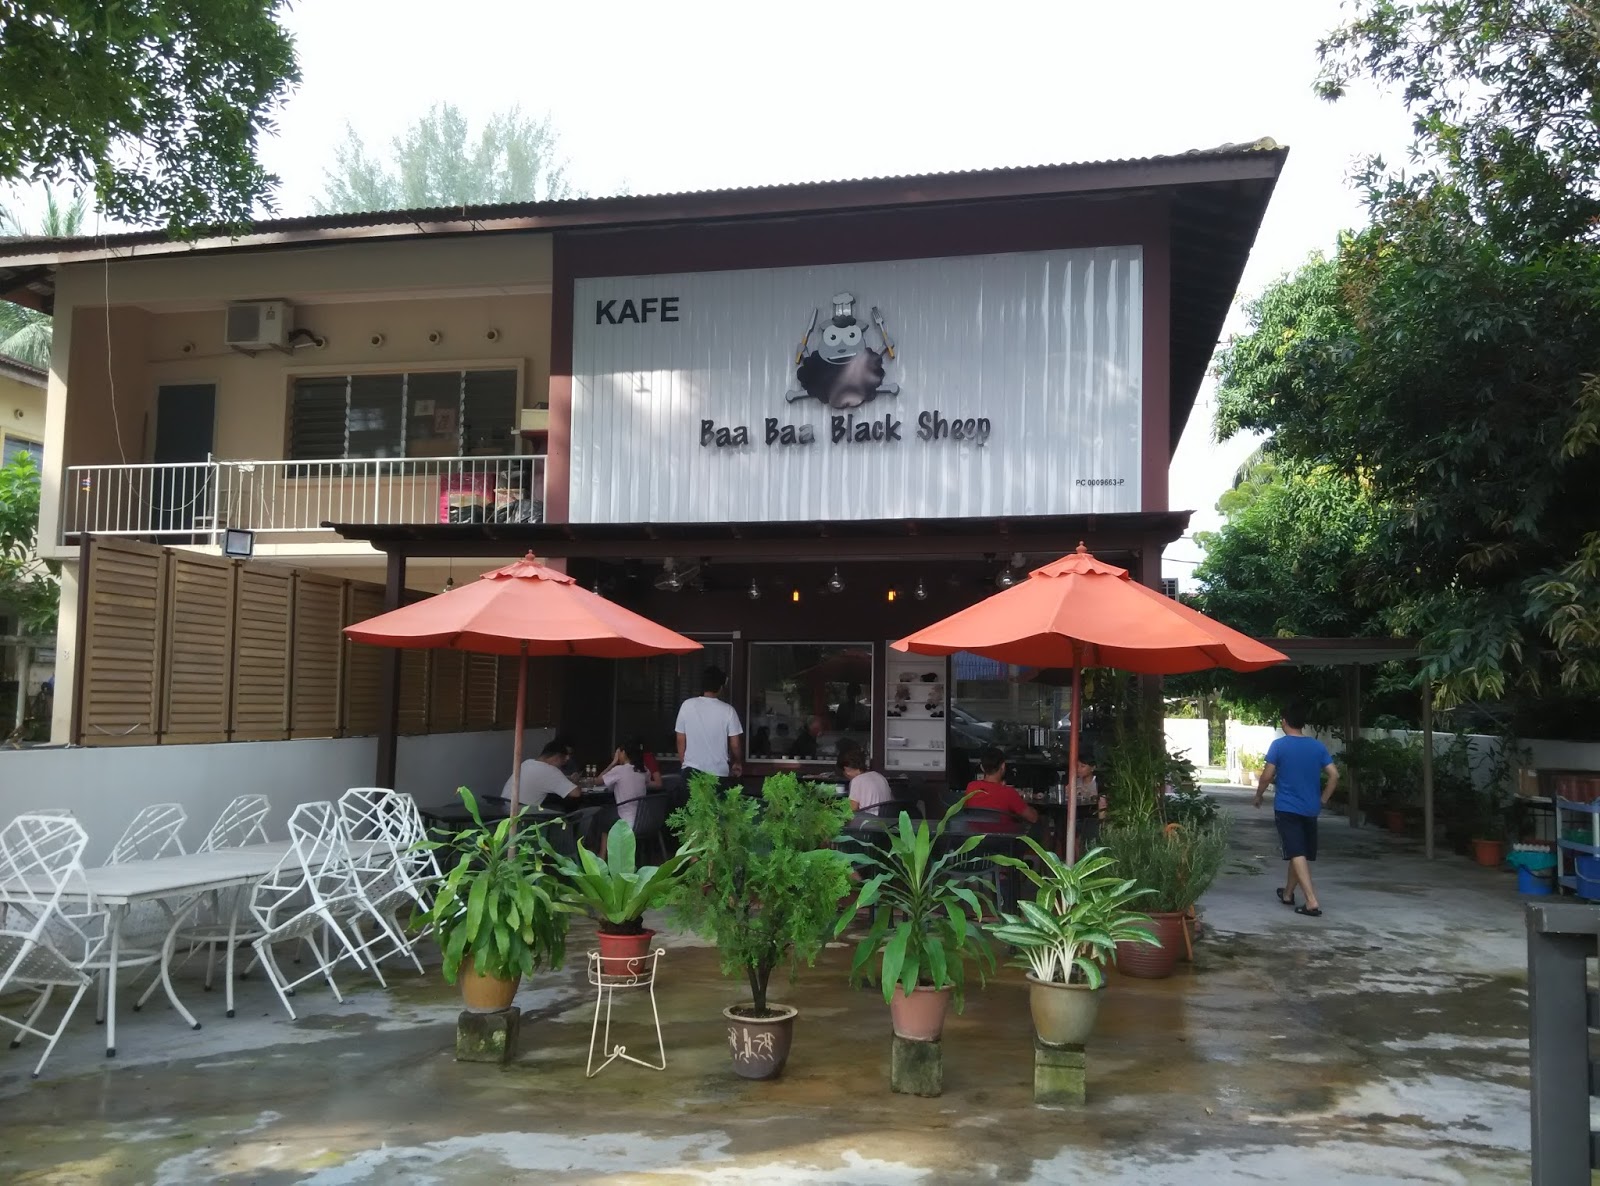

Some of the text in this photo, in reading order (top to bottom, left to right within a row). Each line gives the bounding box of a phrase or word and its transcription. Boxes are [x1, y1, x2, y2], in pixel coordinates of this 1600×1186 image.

[596, 297, 679, 324] KAFE
[700, 410, 990, 447] Baa Baa Black Sheep
